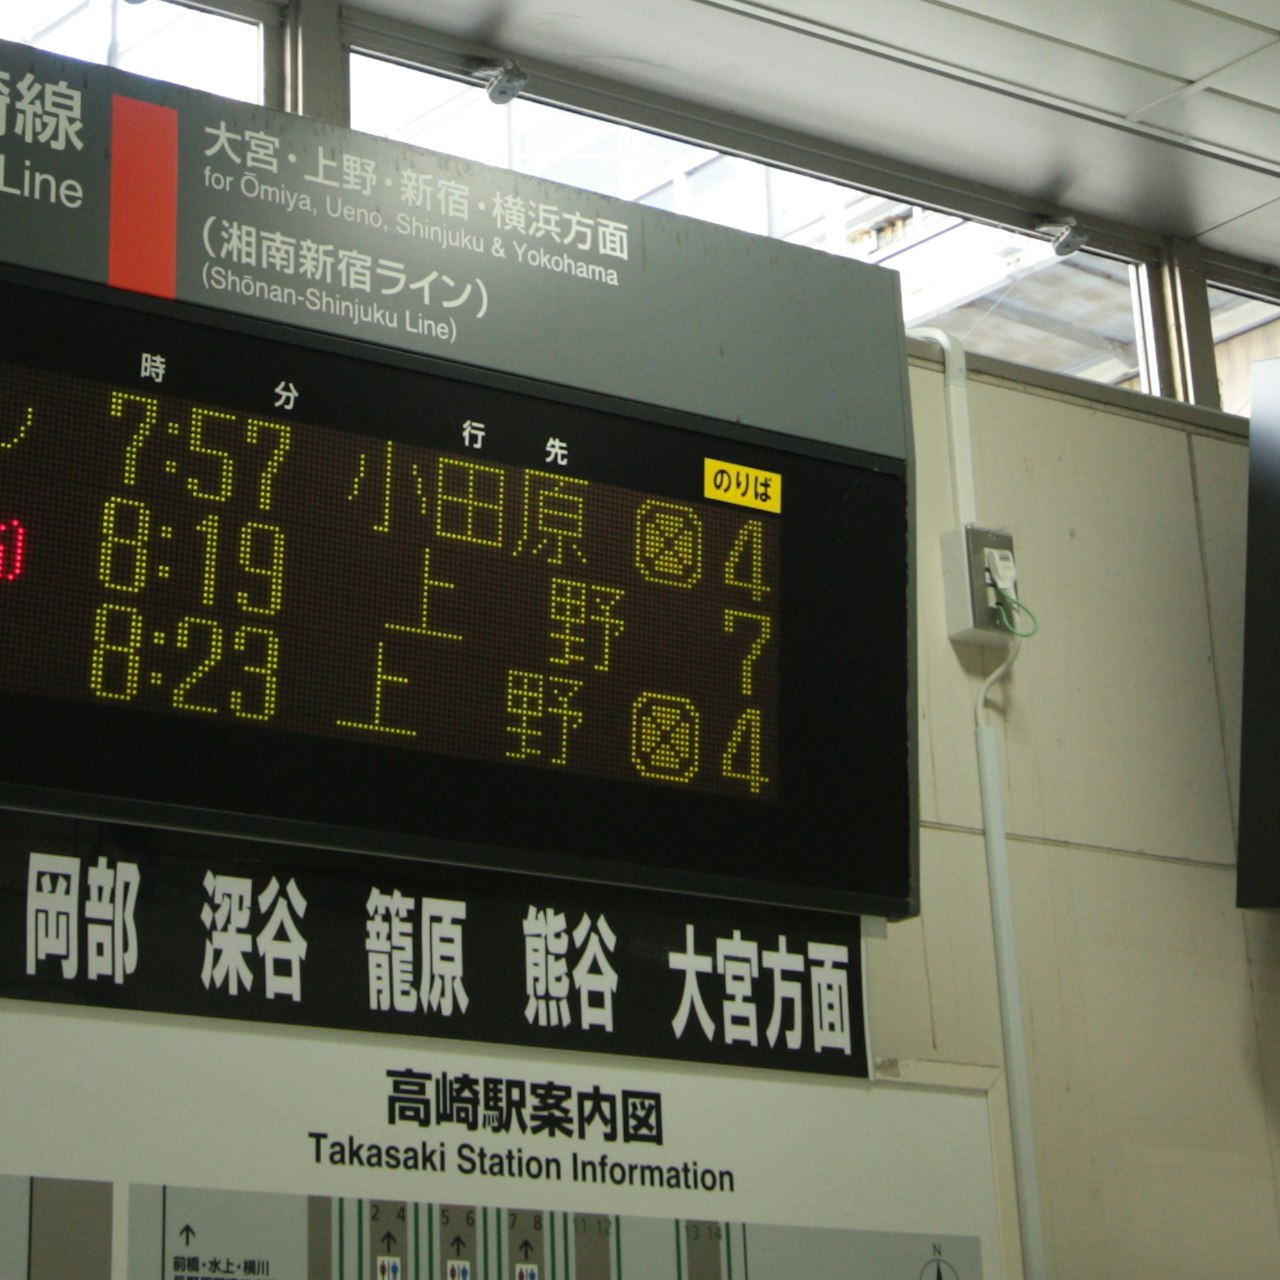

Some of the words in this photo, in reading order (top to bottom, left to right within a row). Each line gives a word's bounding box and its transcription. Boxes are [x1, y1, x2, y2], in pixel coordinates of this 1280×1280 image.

[204, 120, 630, 261] 大宮・上野・新宿・横浜方面
[204, 167, 232, 192] for
[239, 171, 318, 217] Ōmiya,
[325, 196, 389, 232] Ueno,
[395, 213, 485, 253] Shinjuku
[491, 236, 506, 258] &
[512, 241, 620, 287] Yokohama
[201, 214, 489, 319] (湘南新宿ライン)
[404, 308, 458, 344] Line)
[139, 352, 167, 383] 時
[273, 381, 300, 411] 分
[461, 420, 486, 449] 行
[544, 437, 569, 466] 先
[110, 390, 292, 511] 7:57
[346, 439, 590, 565] 小田原
[724, 518, 771, 602] 4
[712, 468, 773, 503] のりば
[98, 495, 286, 616] 8:19
[724, 608, 771, 696] 7
[90, 602, 279, 721] 8:23
[721, 707, 770, 794] 4
[26, 851, 142, 986] 岡部
[200, 869, 309, 1003] 深谷
[365, 885, 470, 1018] 籠原
[521, 904, 619, 1034] 熊谷
[667, 923, 852, 1056] 大宮方面
[385, 1067, 665, 1146] 高崎駅案内図
[308, 1131, 447, 1173] Takasaki
[457, 1141, 562, 1182] Station
[572, 1151, 735, 1193] Information
[371, 1204, 380, 1221] 2
[440, 1209, 450, 1226] 5
[466, 1210, 476, 1227] 6
[932, 1243, 942, 1257] N
